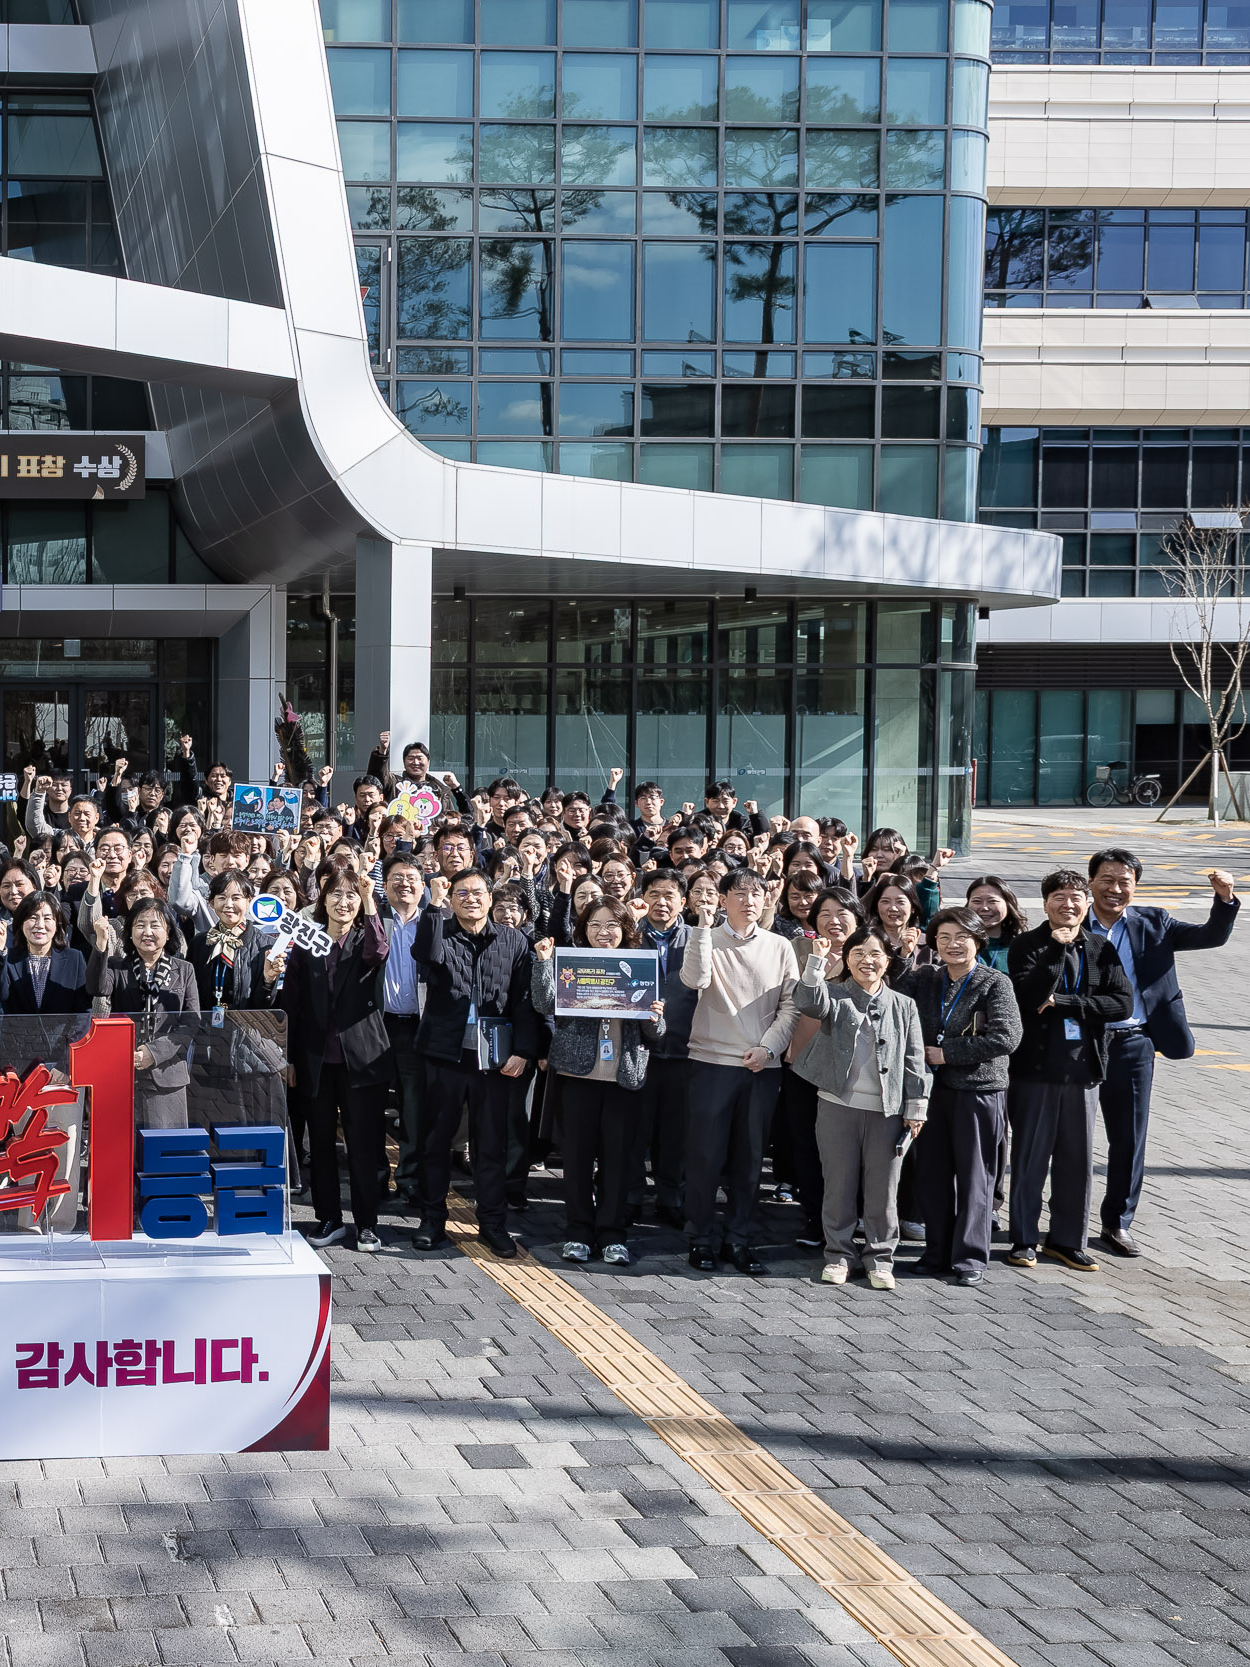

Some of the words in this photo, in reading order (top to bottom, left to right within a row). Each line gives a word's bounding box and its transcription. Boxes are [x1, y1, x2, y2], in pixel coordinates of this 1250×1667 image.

[16, 456, 66, 478] 표창
[73, 455, 124, 478] 수상
[279, 911, 332, 956] 광진구
[15, 1336, 270, 1390] 감사합니다.
